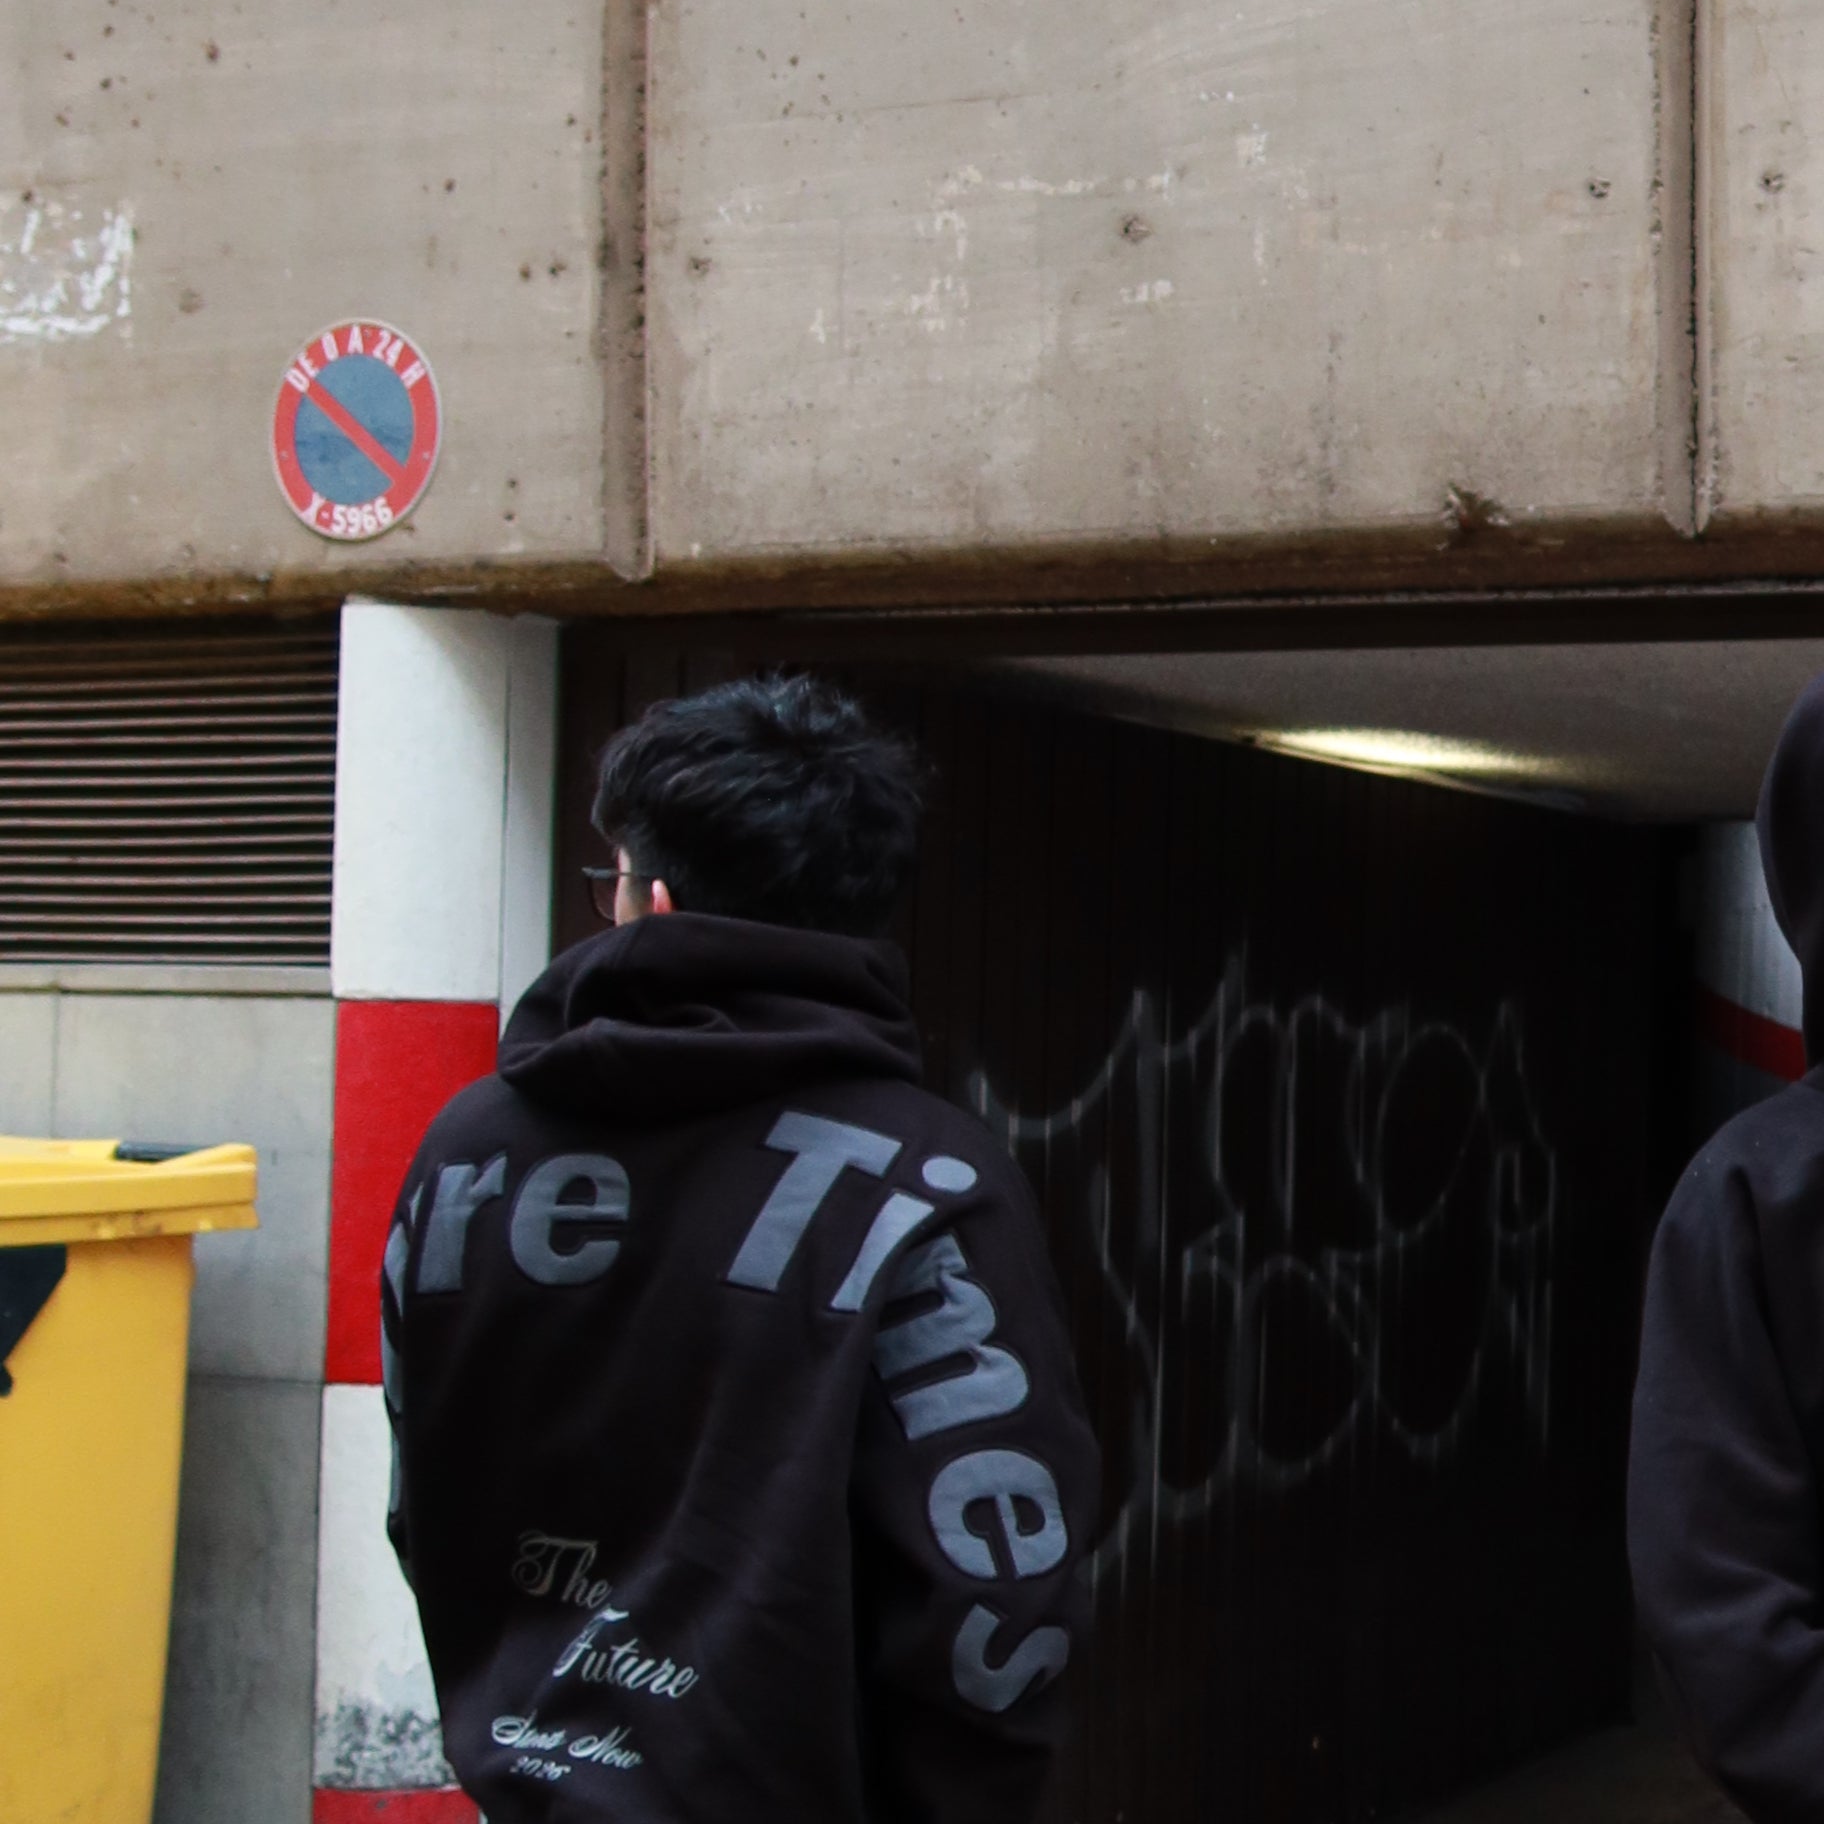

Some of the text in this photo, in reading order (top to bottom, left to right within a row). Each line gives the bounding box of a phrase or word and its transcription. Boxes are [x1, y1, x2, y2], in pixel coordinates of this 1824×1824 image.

[284, 352, 319, 393] DE
[347, 325, 364, 354] A
[373, 329, 404, 367] 24
[400, 360, 427, 389] H
[720, 1109, 1072, 1714] Times
[511, 1529, 613, 1609] The
[552, 1605, 700, 1698] Future
[567, 1726, 645, 1770] Now
